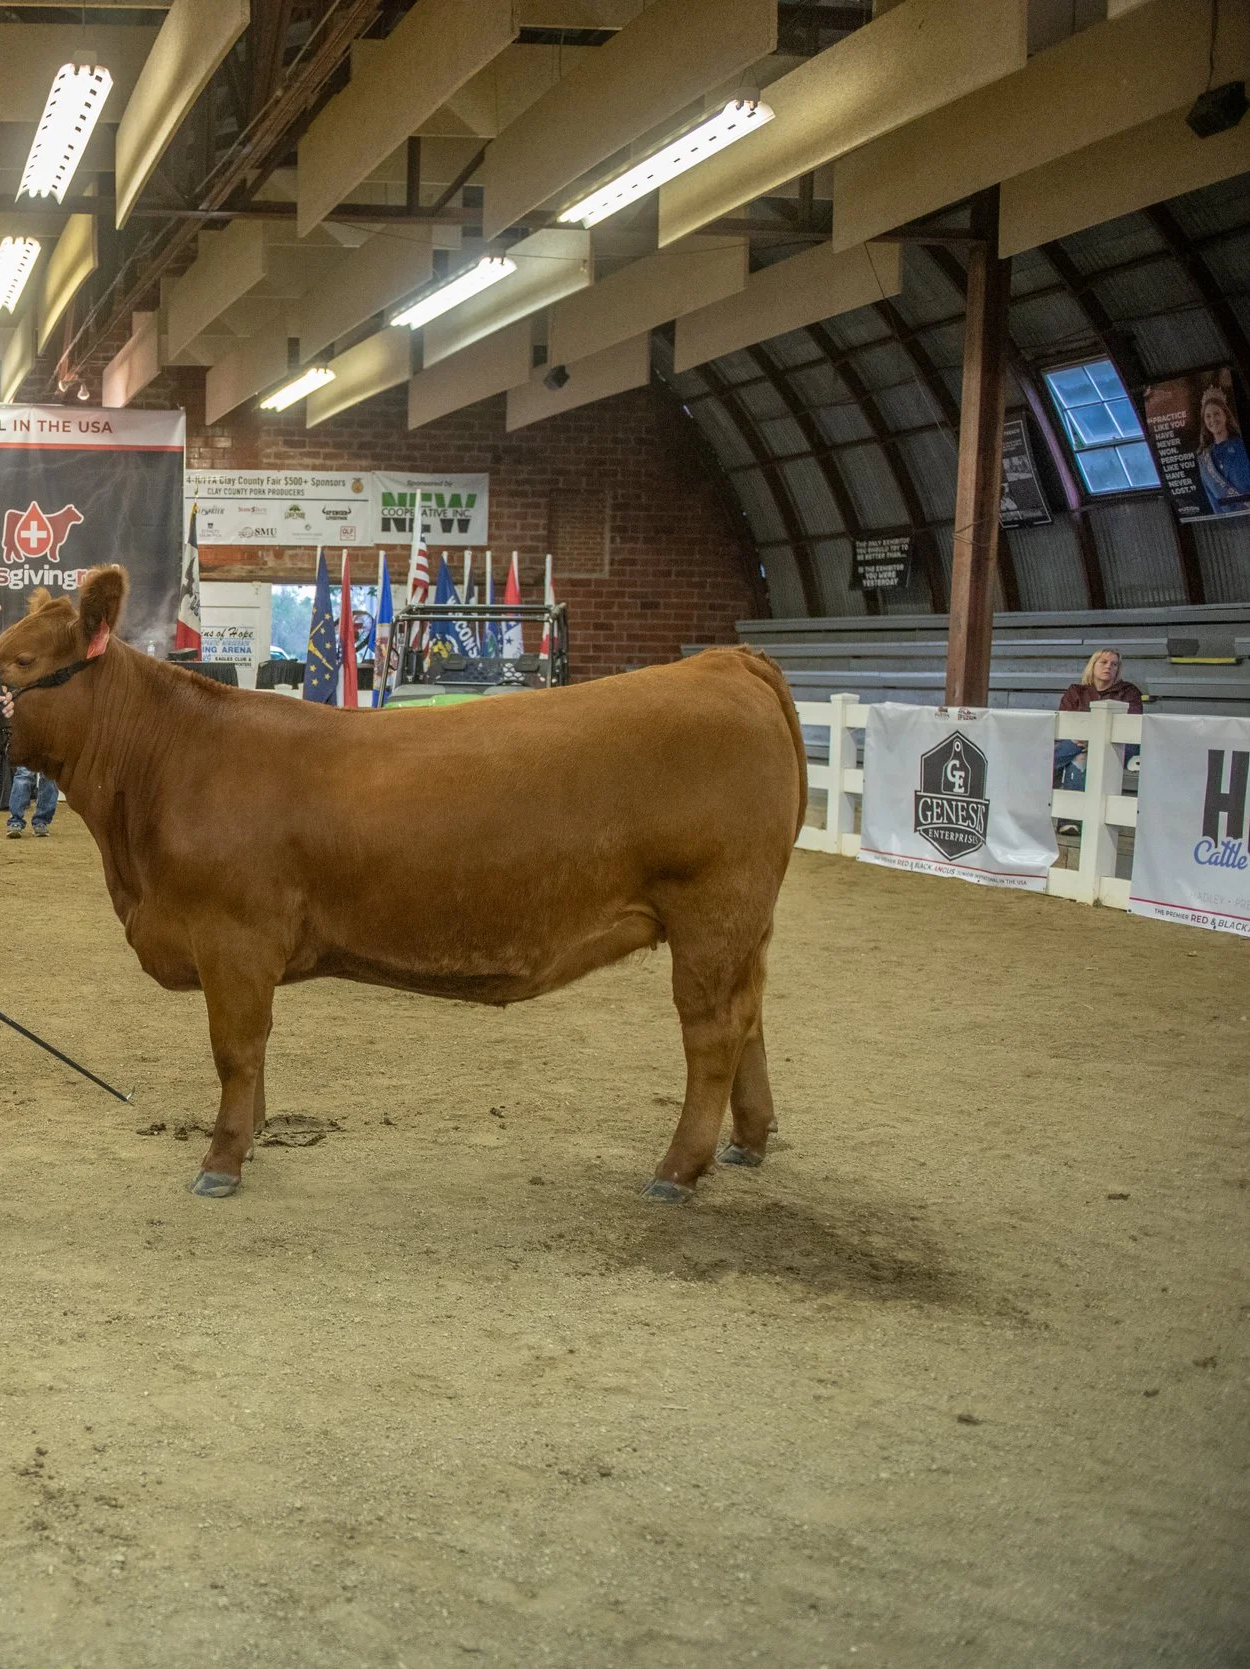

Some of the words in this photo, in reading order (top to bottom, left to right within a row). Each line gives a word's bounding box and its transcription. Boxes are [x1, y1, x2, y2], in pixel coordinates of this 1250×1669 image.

[13, 420, 30, 432] IN
[37, 420, 72, 433] THE
[78, 421, 113, 434] USA
[1153, 424, 1169, 432] LIKE
[1170, 420, 1185, 428] YOU
[1155, 431, 1175, 440] HAVE
[1156, 438, 1181, 448] NEVER
[1160, 452, 1195, 464] PERFORM
[1162, 464, 1179, 472] LIKE
[1180, 461, 1196, 469] YOU
[1165, 471, 1185, 480] HAVE
[238, 476, 264, 486] County
[267, 476, 281, 485] Fair
[284, 477, 308, 486] $500+
[311, 477, 346, 488] Sponsors
[1168, 478, 1193, 487] NEVER
[249, 488, 267, 496] PORK
[268, 488, 305, 496] PRODUCERS
[381, 508, 448, 518] COOPEATIVE
[255, 527, 277, 536] SMU
[228, 627, 254, 640] Hope
[1202, 749, 1250, 851] H
[918, 797, 985, 834] GENESIS
[928, 829, 979, 845] ENTERPRISES
[1193, 840, 1248, 870] Cattle
[1155, 908, 1164, 916] THE
[1166, 910, 1189, 920] PREMIER
[1191, 914, 1209, 924] RED
[1218, 920, 1247, 932] BLACK
